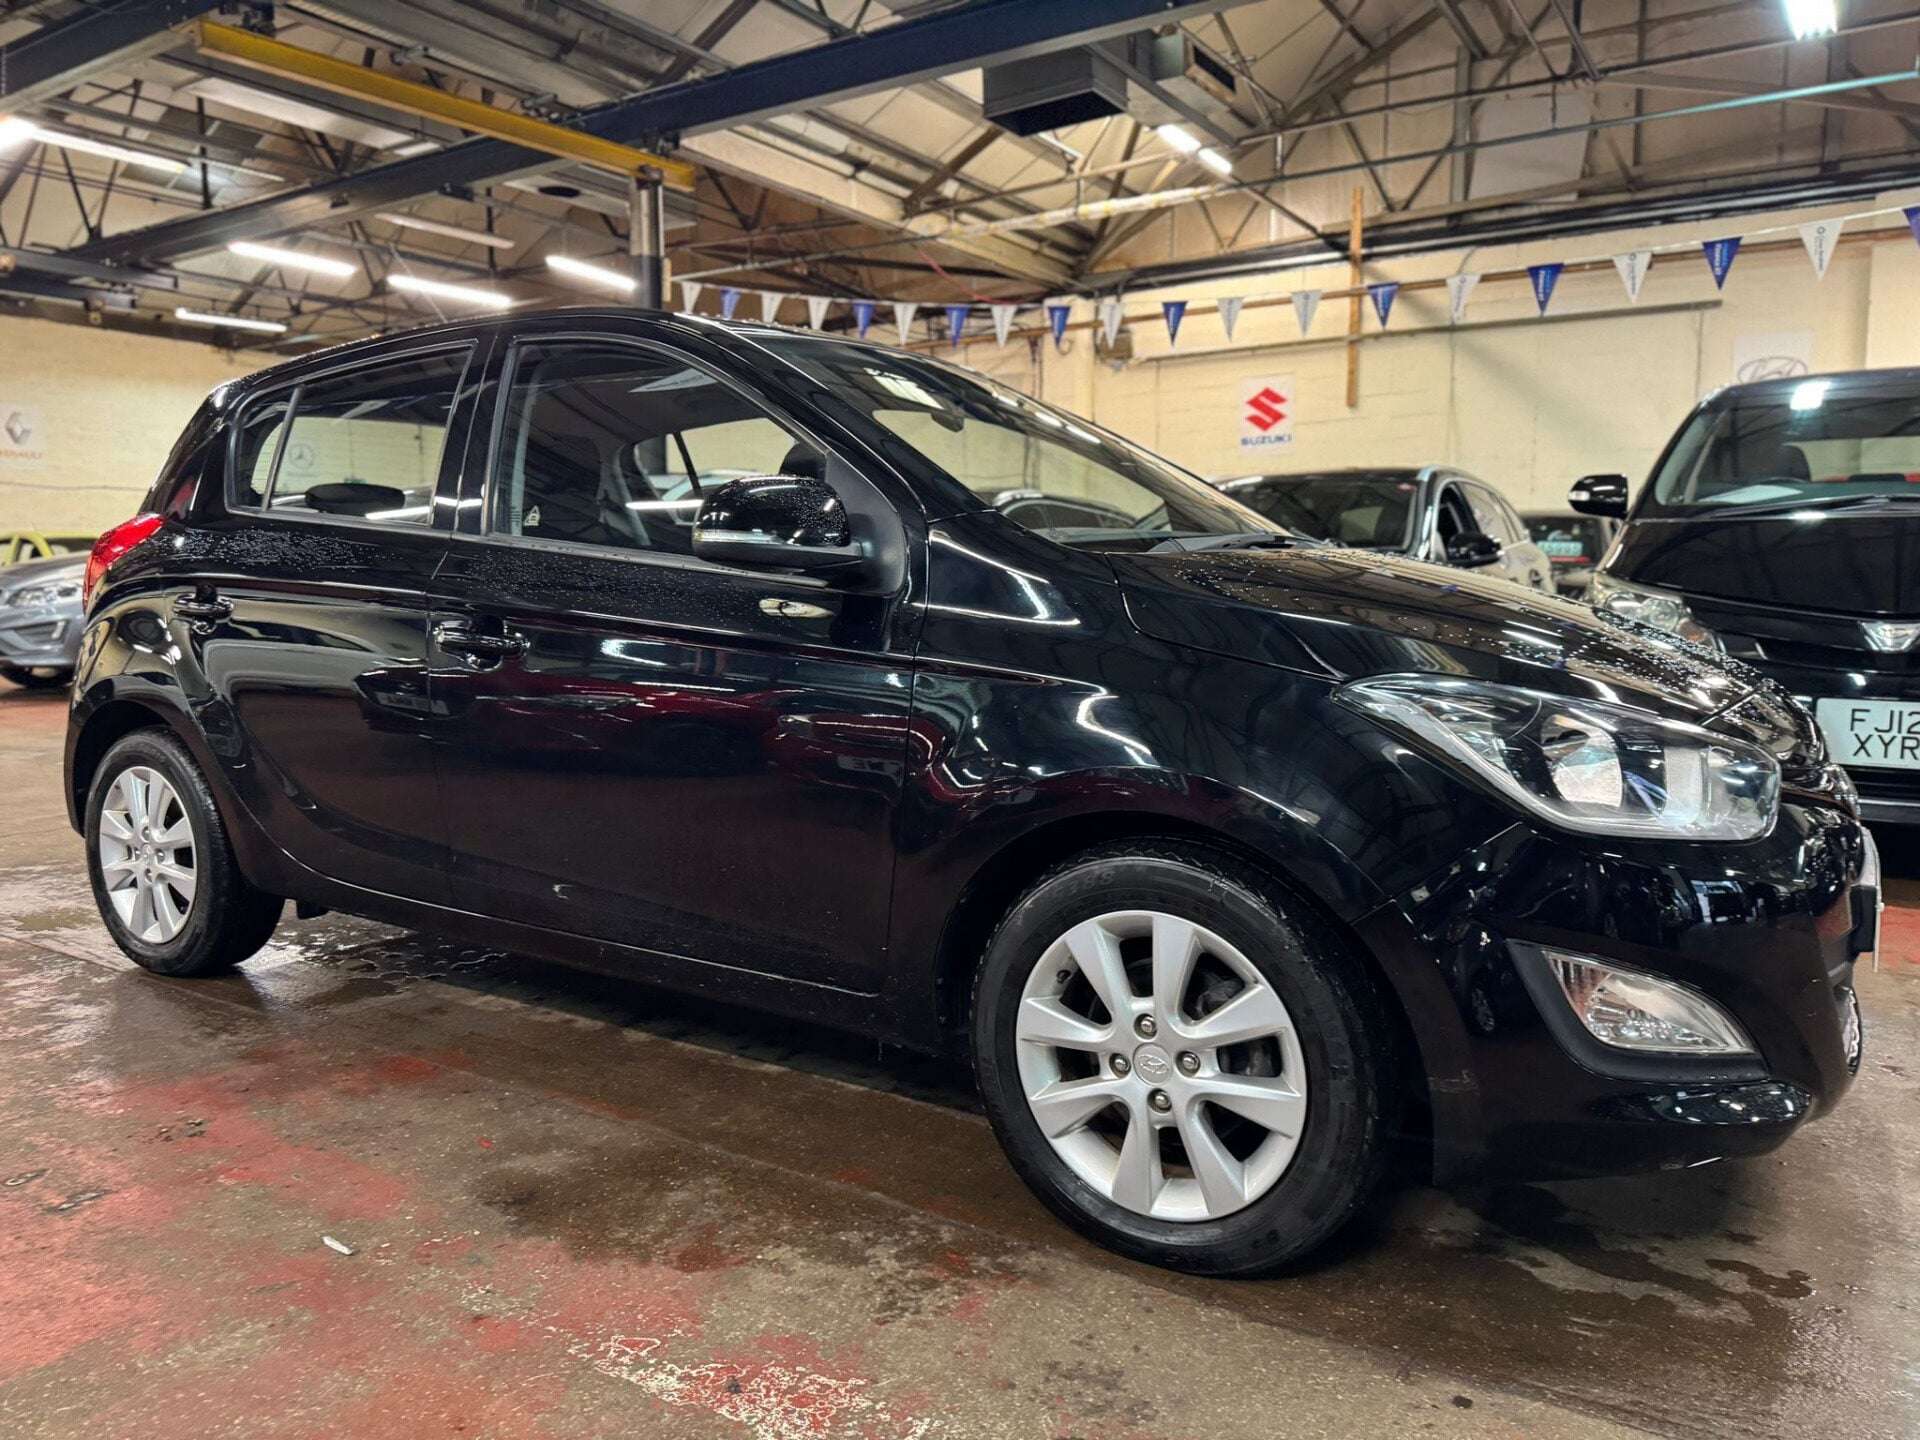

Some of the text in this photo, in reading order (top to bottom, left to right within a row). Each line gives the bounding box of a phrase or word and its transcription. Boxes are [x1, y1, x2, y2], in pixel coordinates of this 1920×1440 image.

[1241, 434, 1292, 446] SUZUKI
[1850, 708, 1920, 734] FJ12
[1853, 733, 1920, 760] XYR
